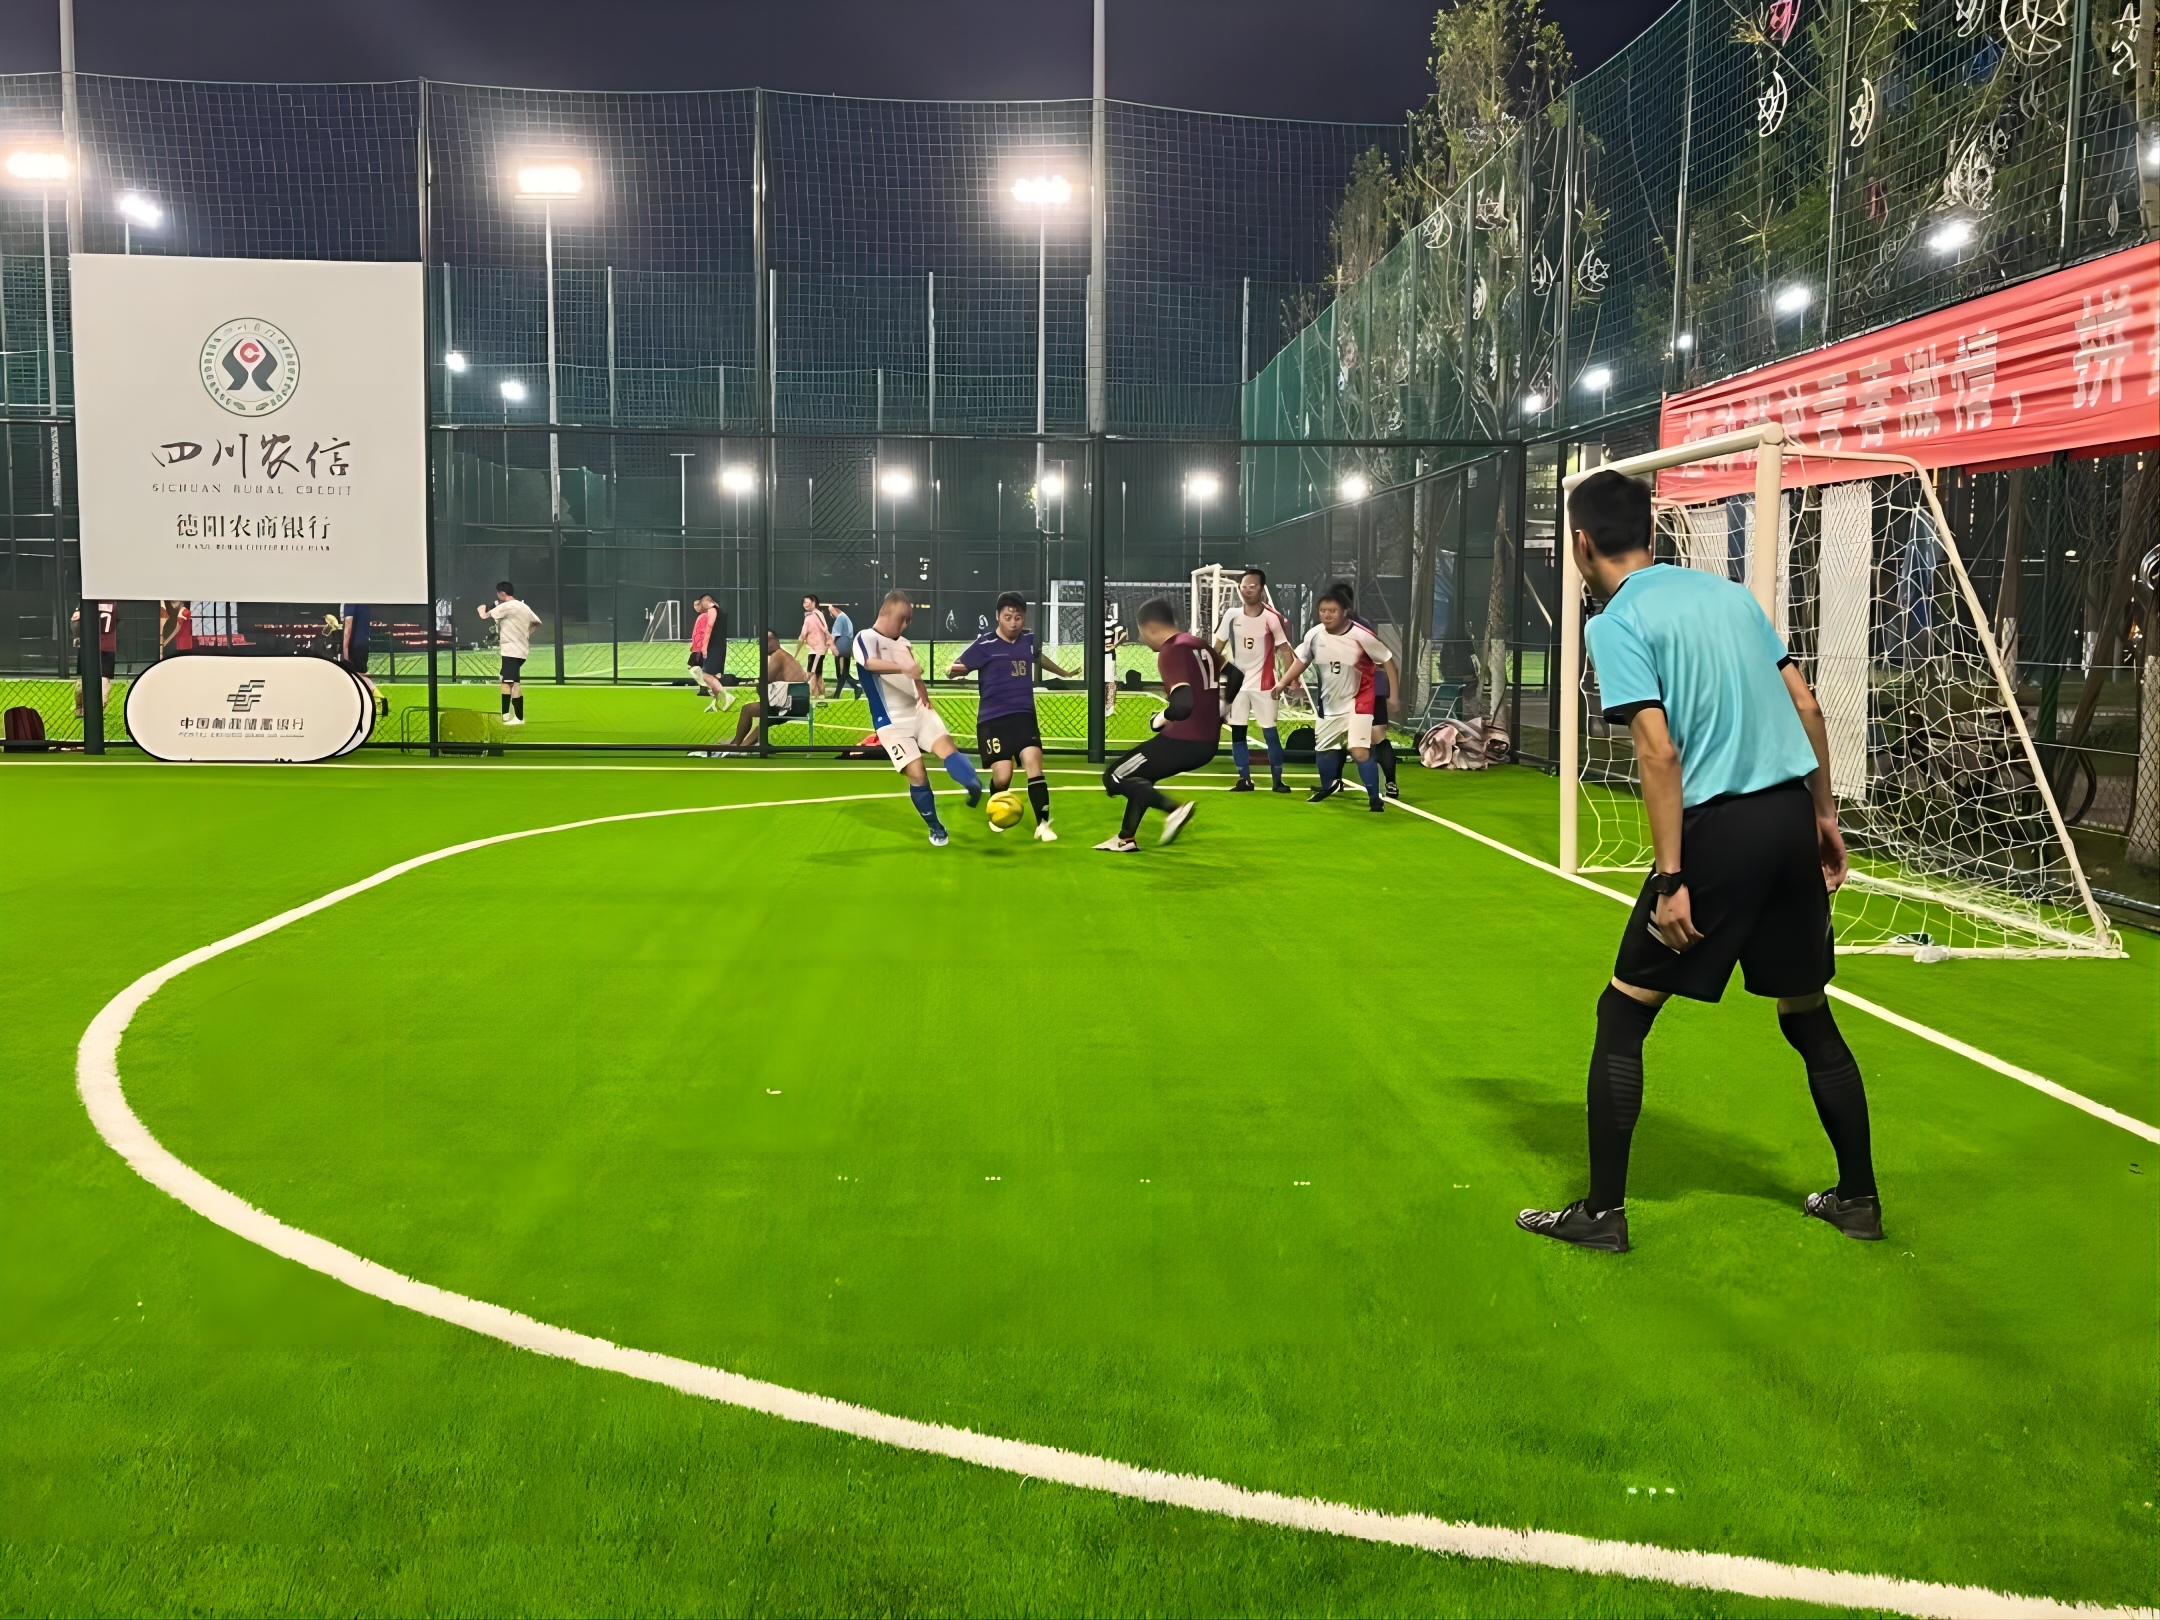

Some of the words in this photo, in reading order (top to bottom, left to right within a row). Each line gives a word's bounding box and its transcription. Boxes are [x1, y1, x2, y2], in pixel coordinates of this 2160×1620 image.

[151, 433, 350, 479] 四川农信
[176, 514, 331, 539] 德阳农商银行
[1192, 648, 1219, 691] 12
